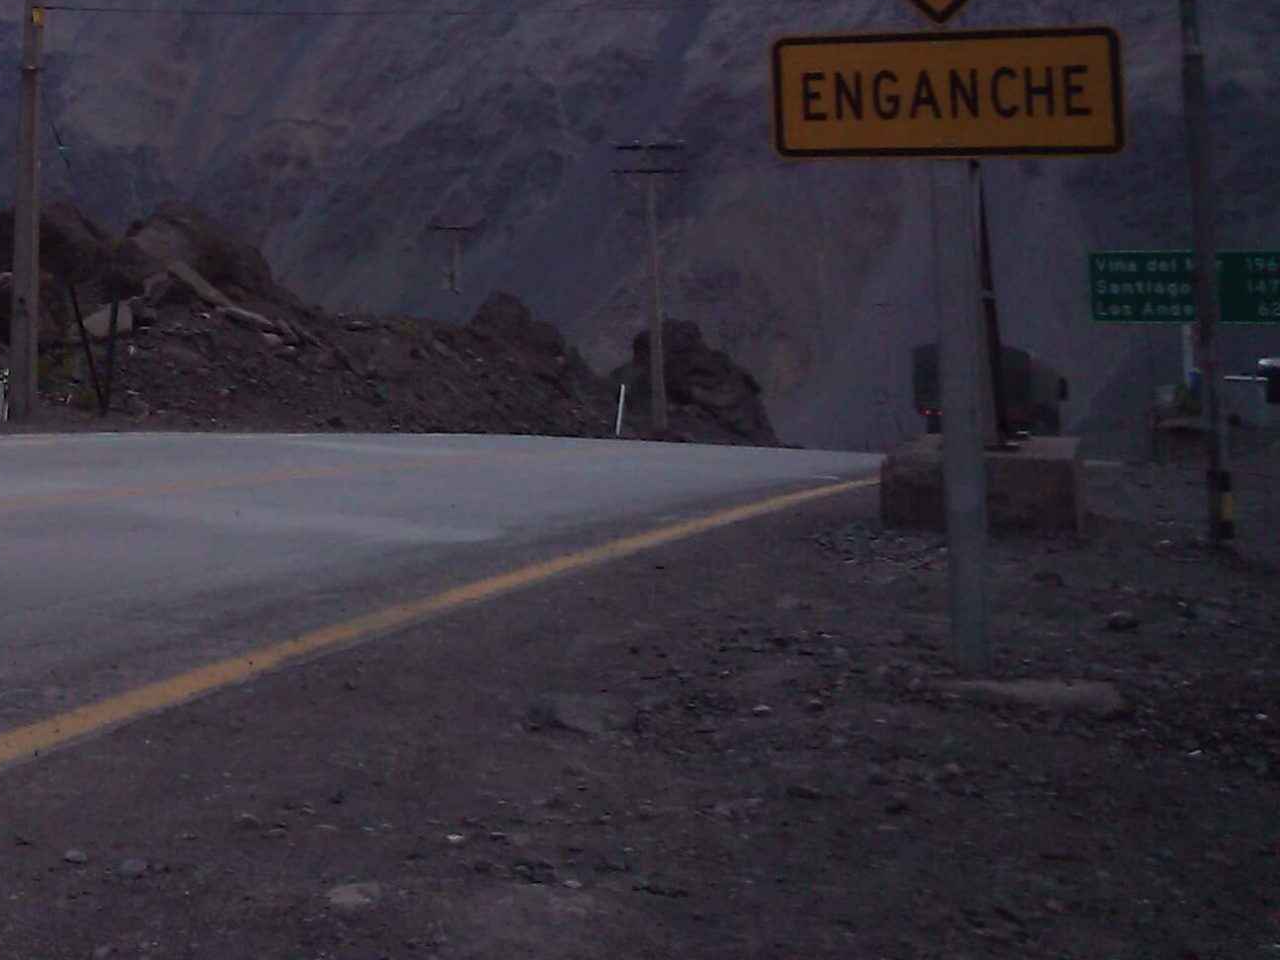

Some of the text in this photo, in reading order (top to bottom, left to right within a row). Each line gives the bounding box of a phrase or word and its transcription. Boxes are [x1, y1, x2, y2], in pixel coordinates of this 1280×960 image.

[801, 65, 1092, 121] ENGANCHE
[1145, 257, 1178, 272] del
[1096, 279, 1192, 296] Santiago
[1097, 302, 1133, 317] Los
[1141, 301, 1194, 317] Ande
